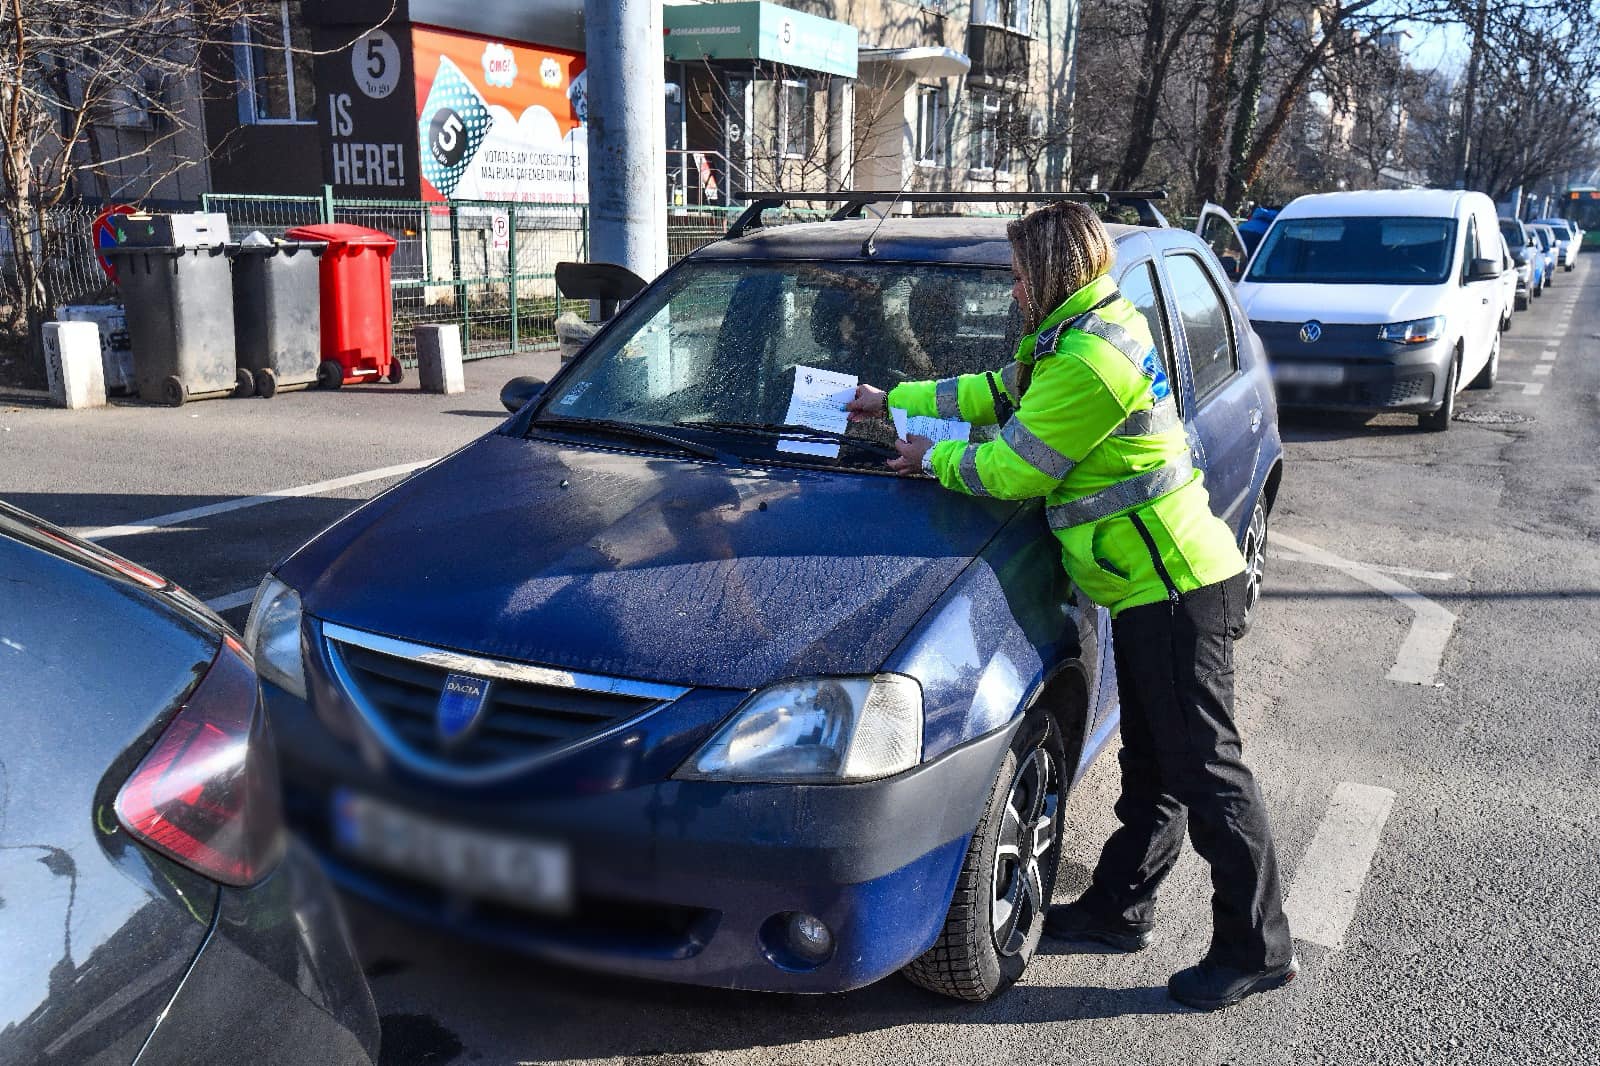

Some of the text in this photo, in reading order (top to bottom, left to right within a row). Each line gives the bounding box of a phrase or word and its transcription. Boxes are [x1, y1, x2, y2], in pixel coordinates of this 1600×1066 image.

[783, 22, 791, 44] 5
[366, 38, 386, 78] 5
[489, 59, 511, 72] OMG!
[329, 93, 353, 136] IS
[438, 113, 463, 151] 5
[333, 143, 405, 186] HERE!
[497, 220, 505, 234] P
[447, 682, 480, 696] DACIA
